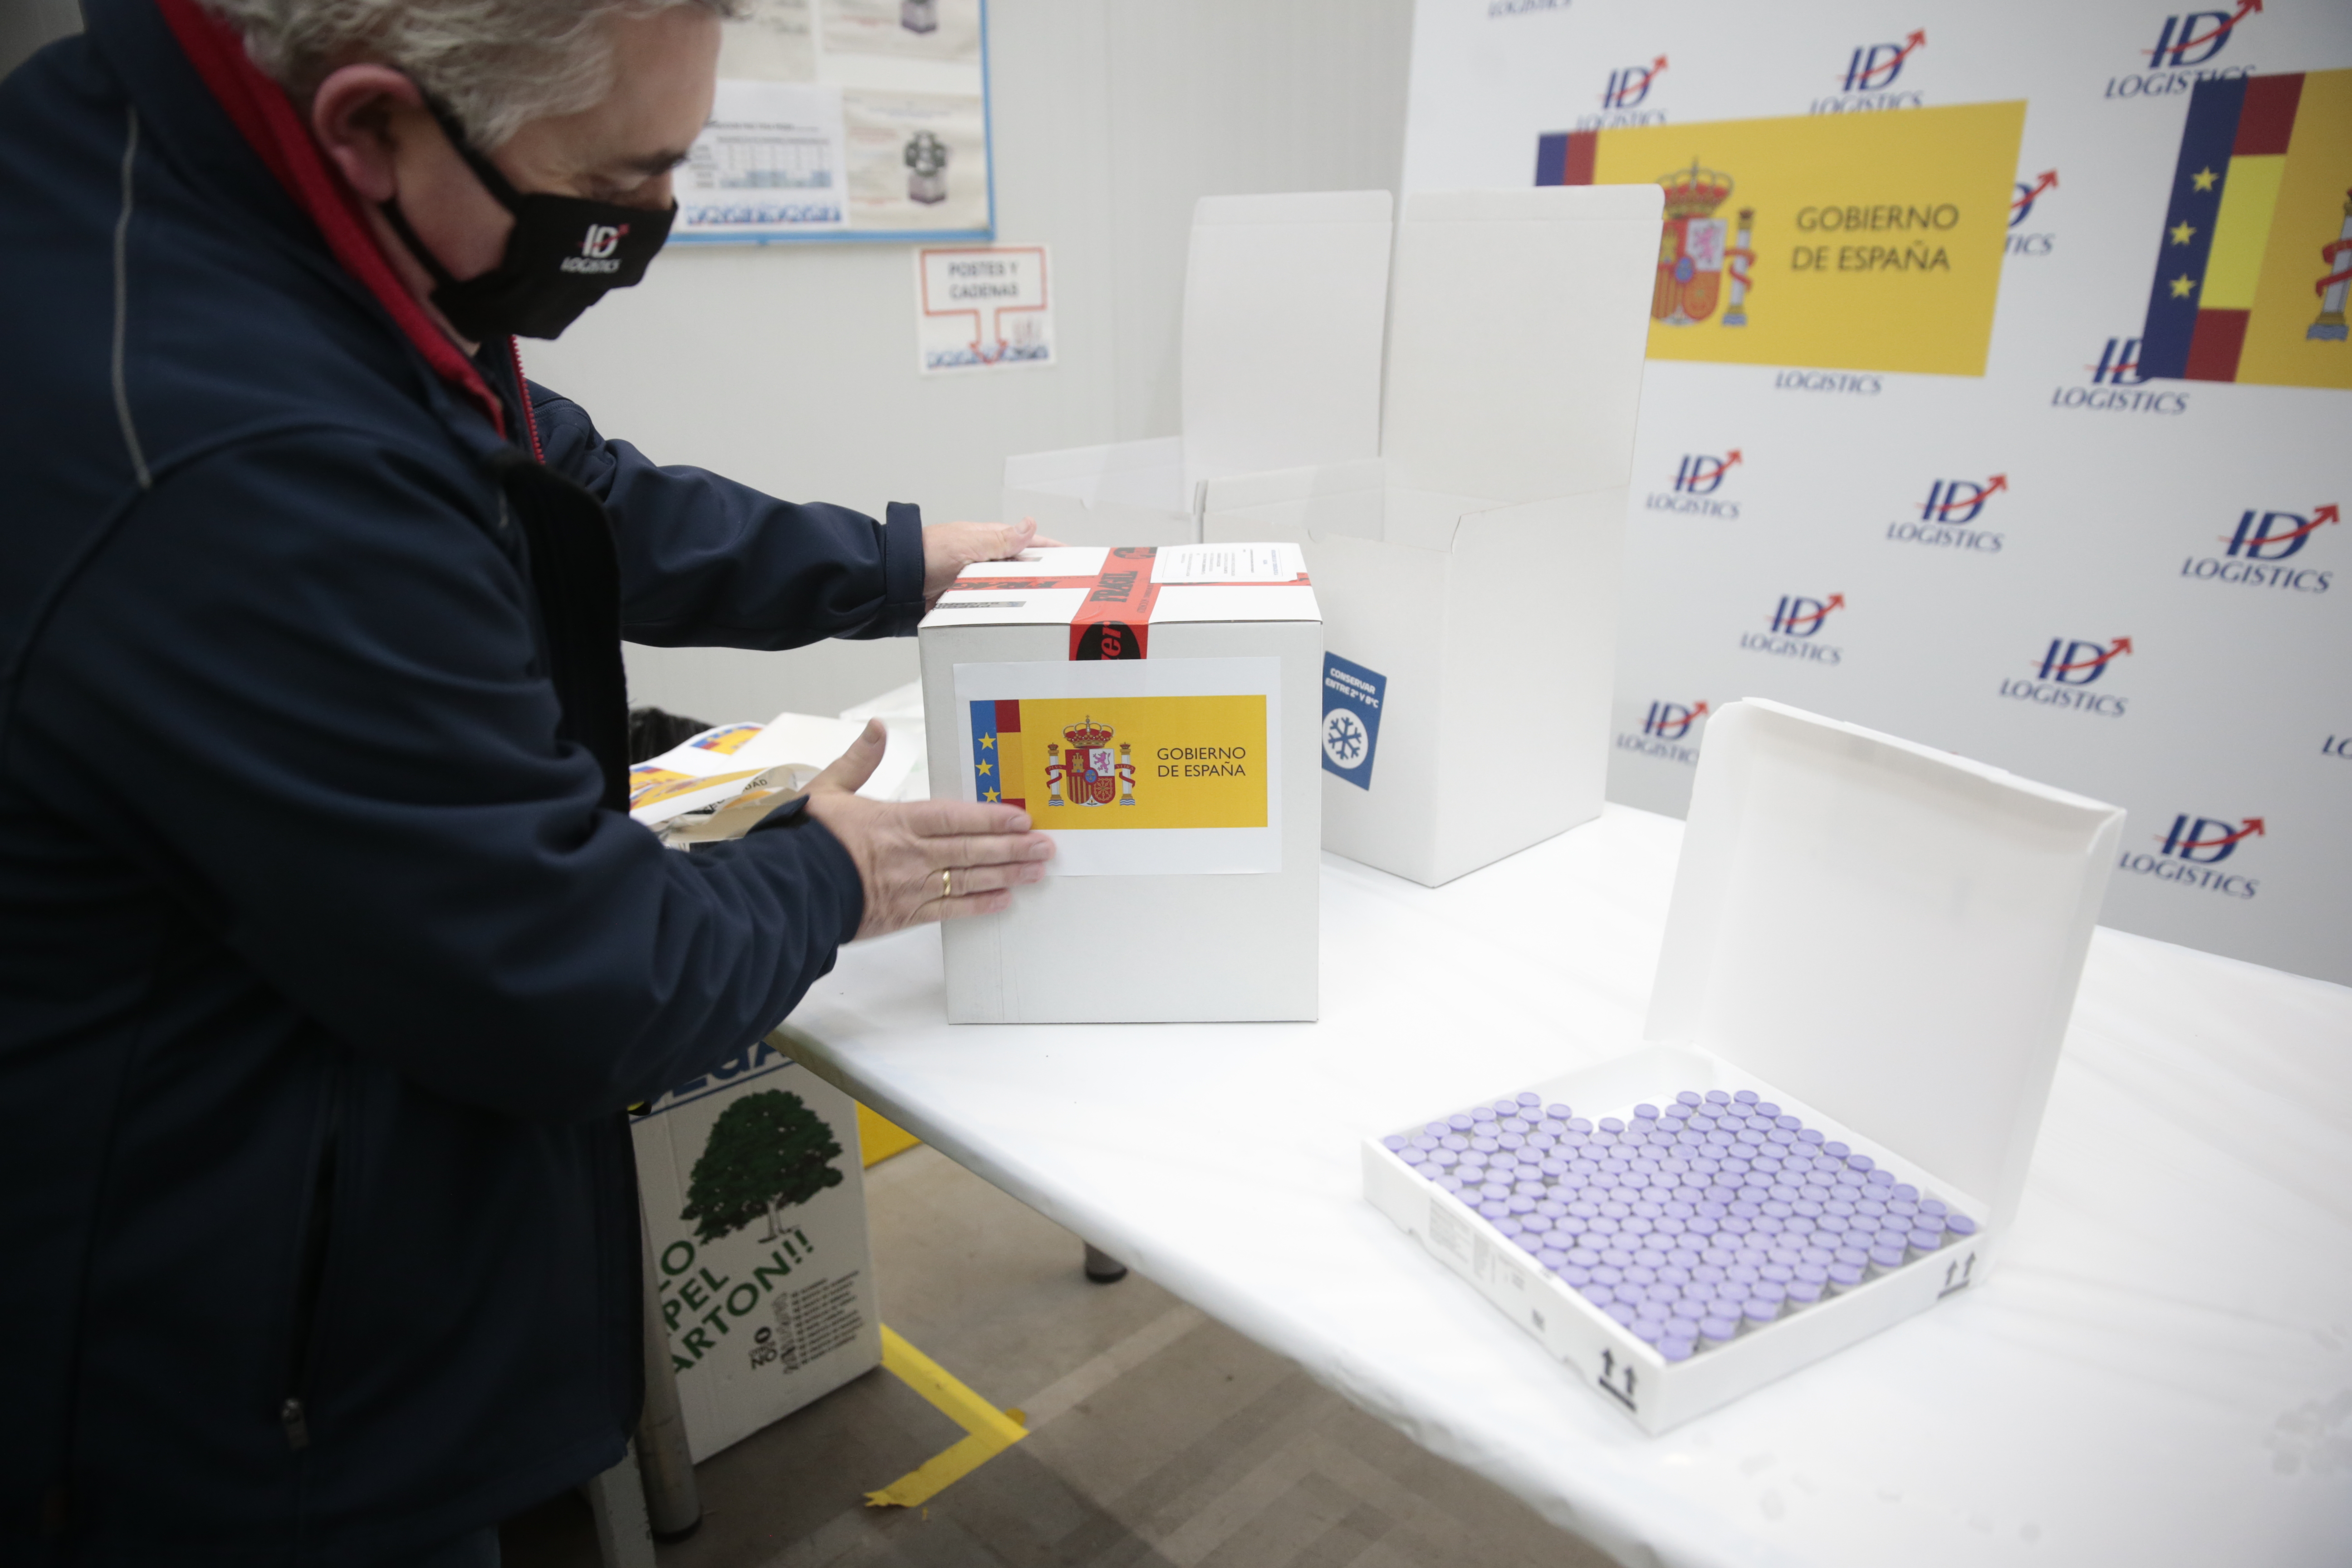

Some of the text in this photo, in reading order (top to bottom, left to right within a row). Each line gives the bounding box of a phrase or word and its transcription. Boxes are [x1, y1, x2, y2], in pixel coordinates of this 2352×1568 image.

[2149, 10, 2233, 69] ID
[1842, 43, 1904, 92] ID
[1603, 66, 1650, 109] ID
[1796, 203, 1960, 233] GOBIERNO
[581, 223, 618, 258] ID
[1790, 240, 1950, 271] DE ESPAÑA
[949, 261, 1004, 277] POSTES
[950, 282, 1019, 299] CADENAS
[1775, 370, 1882, 394] LOGISTICS
[2051, 386, 2190, 415] LOGISTICS
[1673, 454, 1725, 495] ID
[1646, 493, 1740, 518] LOGISTICS
[1921, 479, 1986, 525] ID
[1886, 522, 2005, 554] LOGISTICS
[2225, 509, 2312, 561] ID
[2180, 556, 2333, 593] LOGISTICS
[1770, 595, 1827, 637] ID
[1740, 632, 1844, 666] LOGISTICS
[2036, 637, 2110, 686] ID
[1325, 677, 1350, 695] ENTRE
[1330, 668, 1376, 695] CONSERVAR
[2000, 678, 2129, 717] LOGISTICS
[1644, 700, 1692, 741] ID
[1157, 747, 1246, 760] GOBIERNO
[1617, 733, 1700, 765] LOGISTIC
[1158, 761, 1246, 777] DE ESPAÑA
[2160, 813, 2241, 864] ID
[2119, 851, 2259, 899] LOGISTICS
[663, 1268, 730, 1331] PEL
[671, 1230, 814, 1373] ARTON!!
